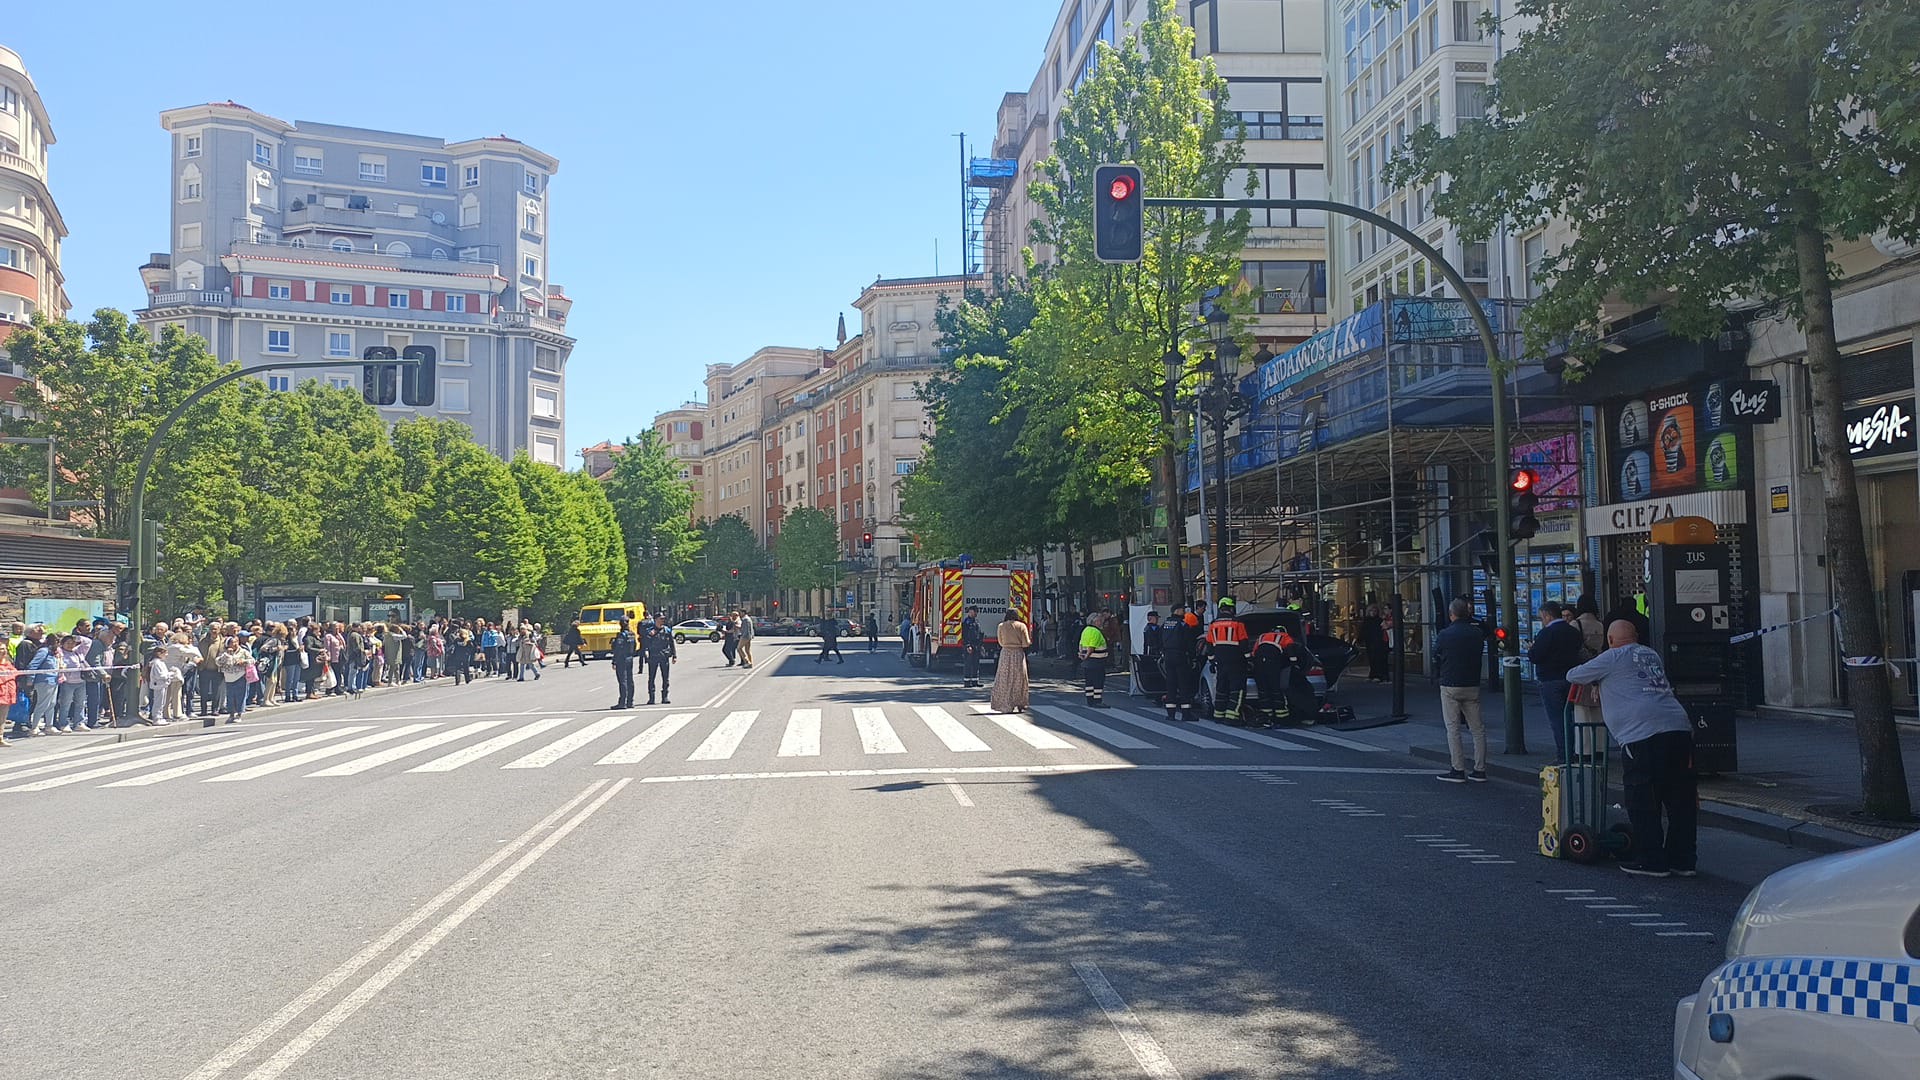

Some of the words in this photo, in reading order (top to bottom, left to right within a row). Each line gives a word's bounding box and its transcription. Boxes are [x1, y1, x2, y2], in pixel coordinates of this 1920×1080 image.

[1264, 336, 1328, 390] ANDAMIOS
[1650, 392, 1689, 412] G-SHOCK
[1612, 503, 1674, 529] CIEZA
[1686, 552, 1706, 564] TUS
[369, 602, 407, 611] zalando
[966, 597, 1006, 605] BOMBEROS
